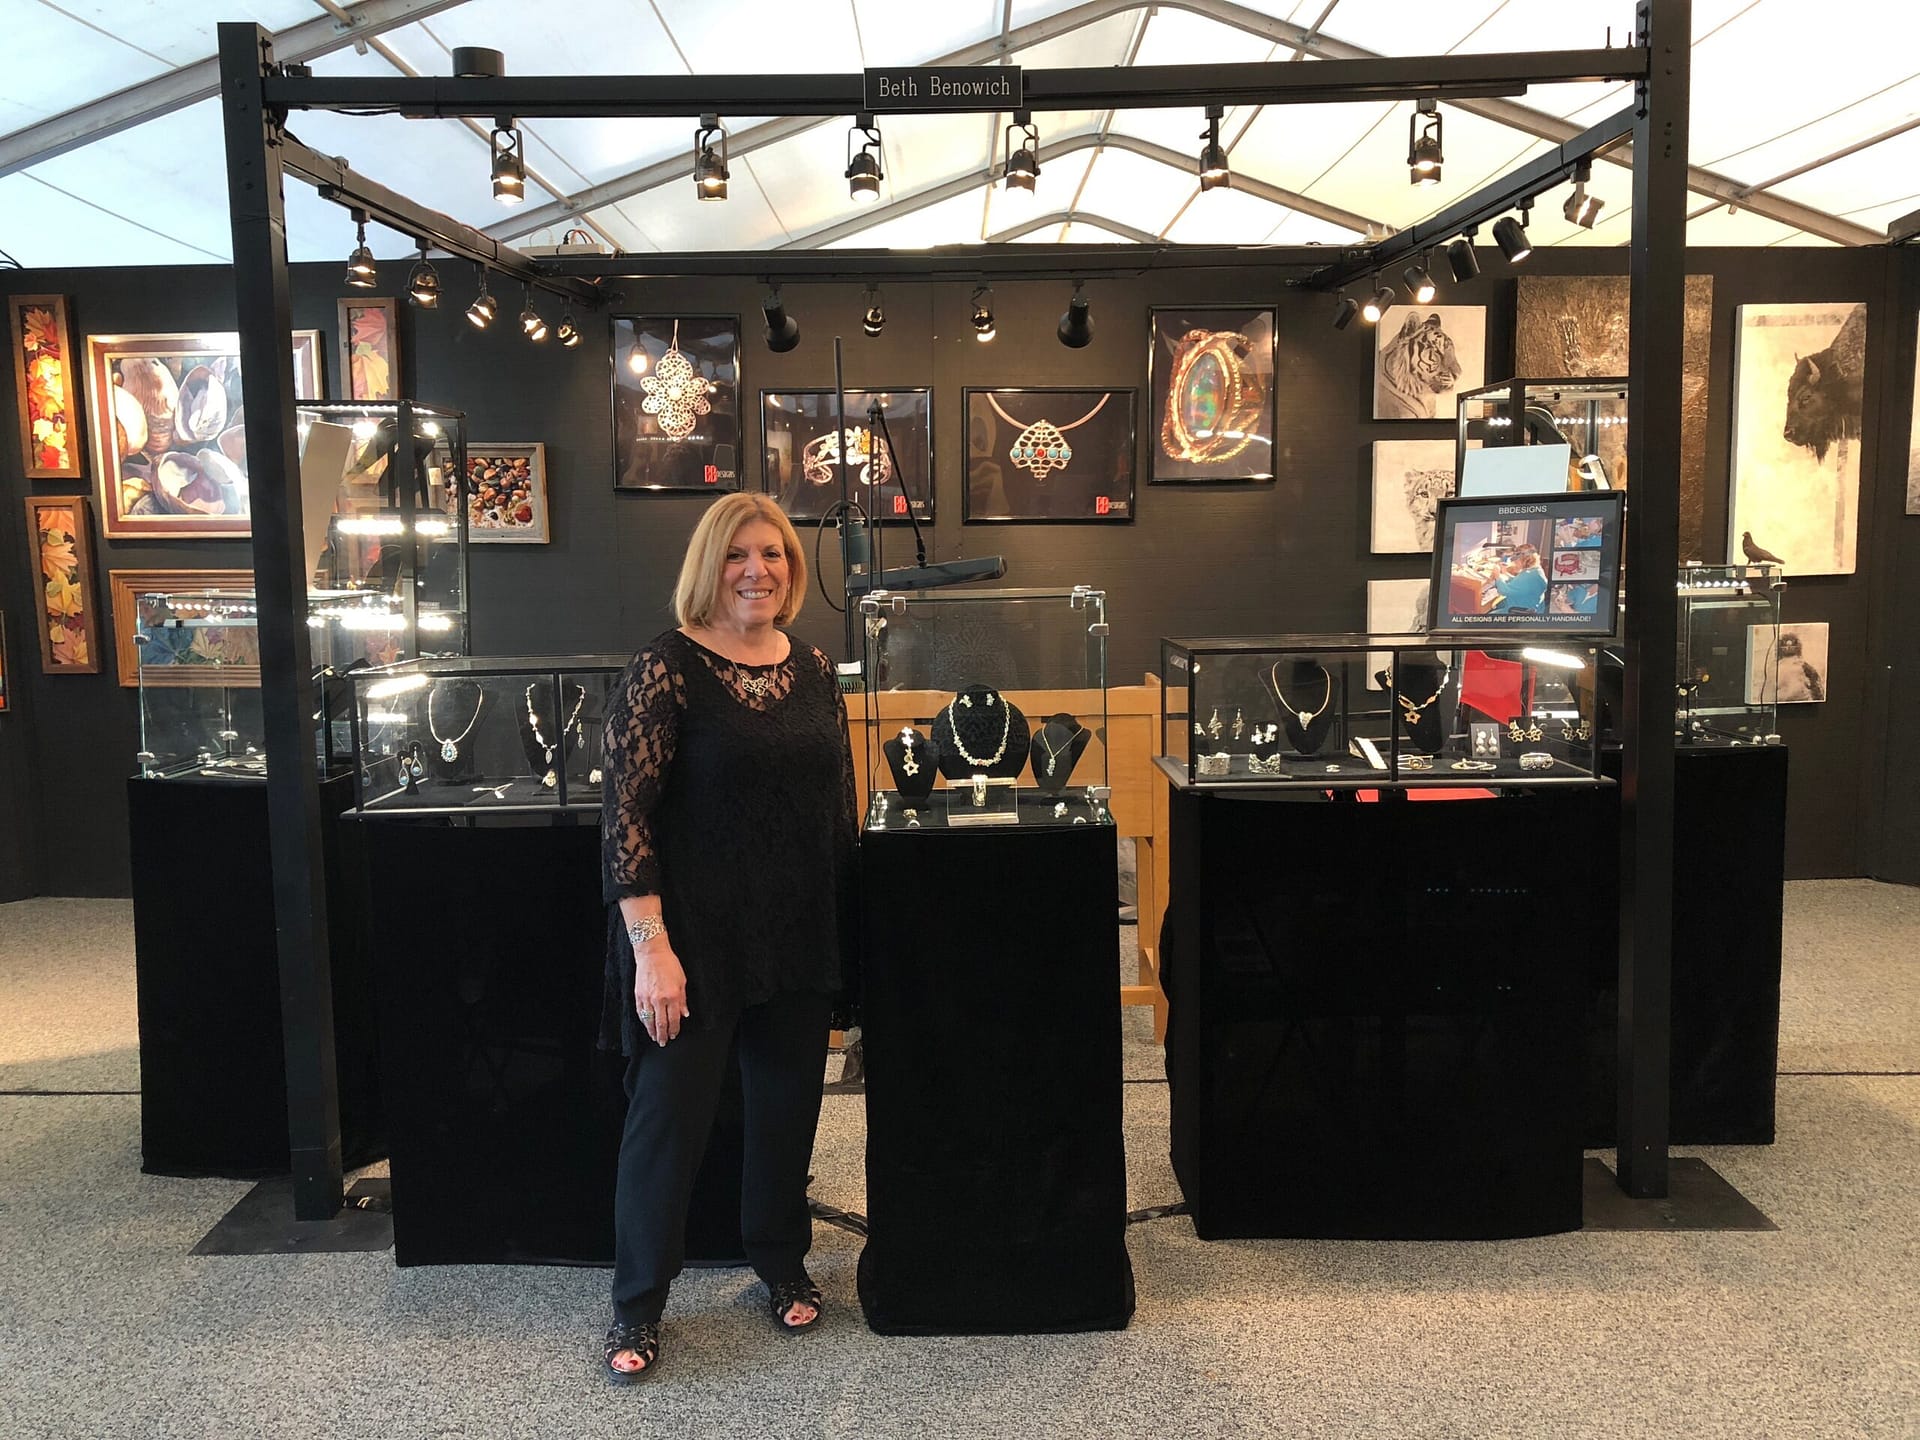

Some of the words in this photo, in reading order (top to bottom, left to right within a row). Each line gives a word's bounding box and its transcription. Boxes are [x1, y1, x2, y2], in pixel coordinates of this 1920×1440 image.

[879, 76, 918, 97] Beth
[930, 75, 1010, 97] Benowich
[1498, 505, 1547, 515] BBDESIGNS
[1508, 615, 1550, 623] PERSONALLY
